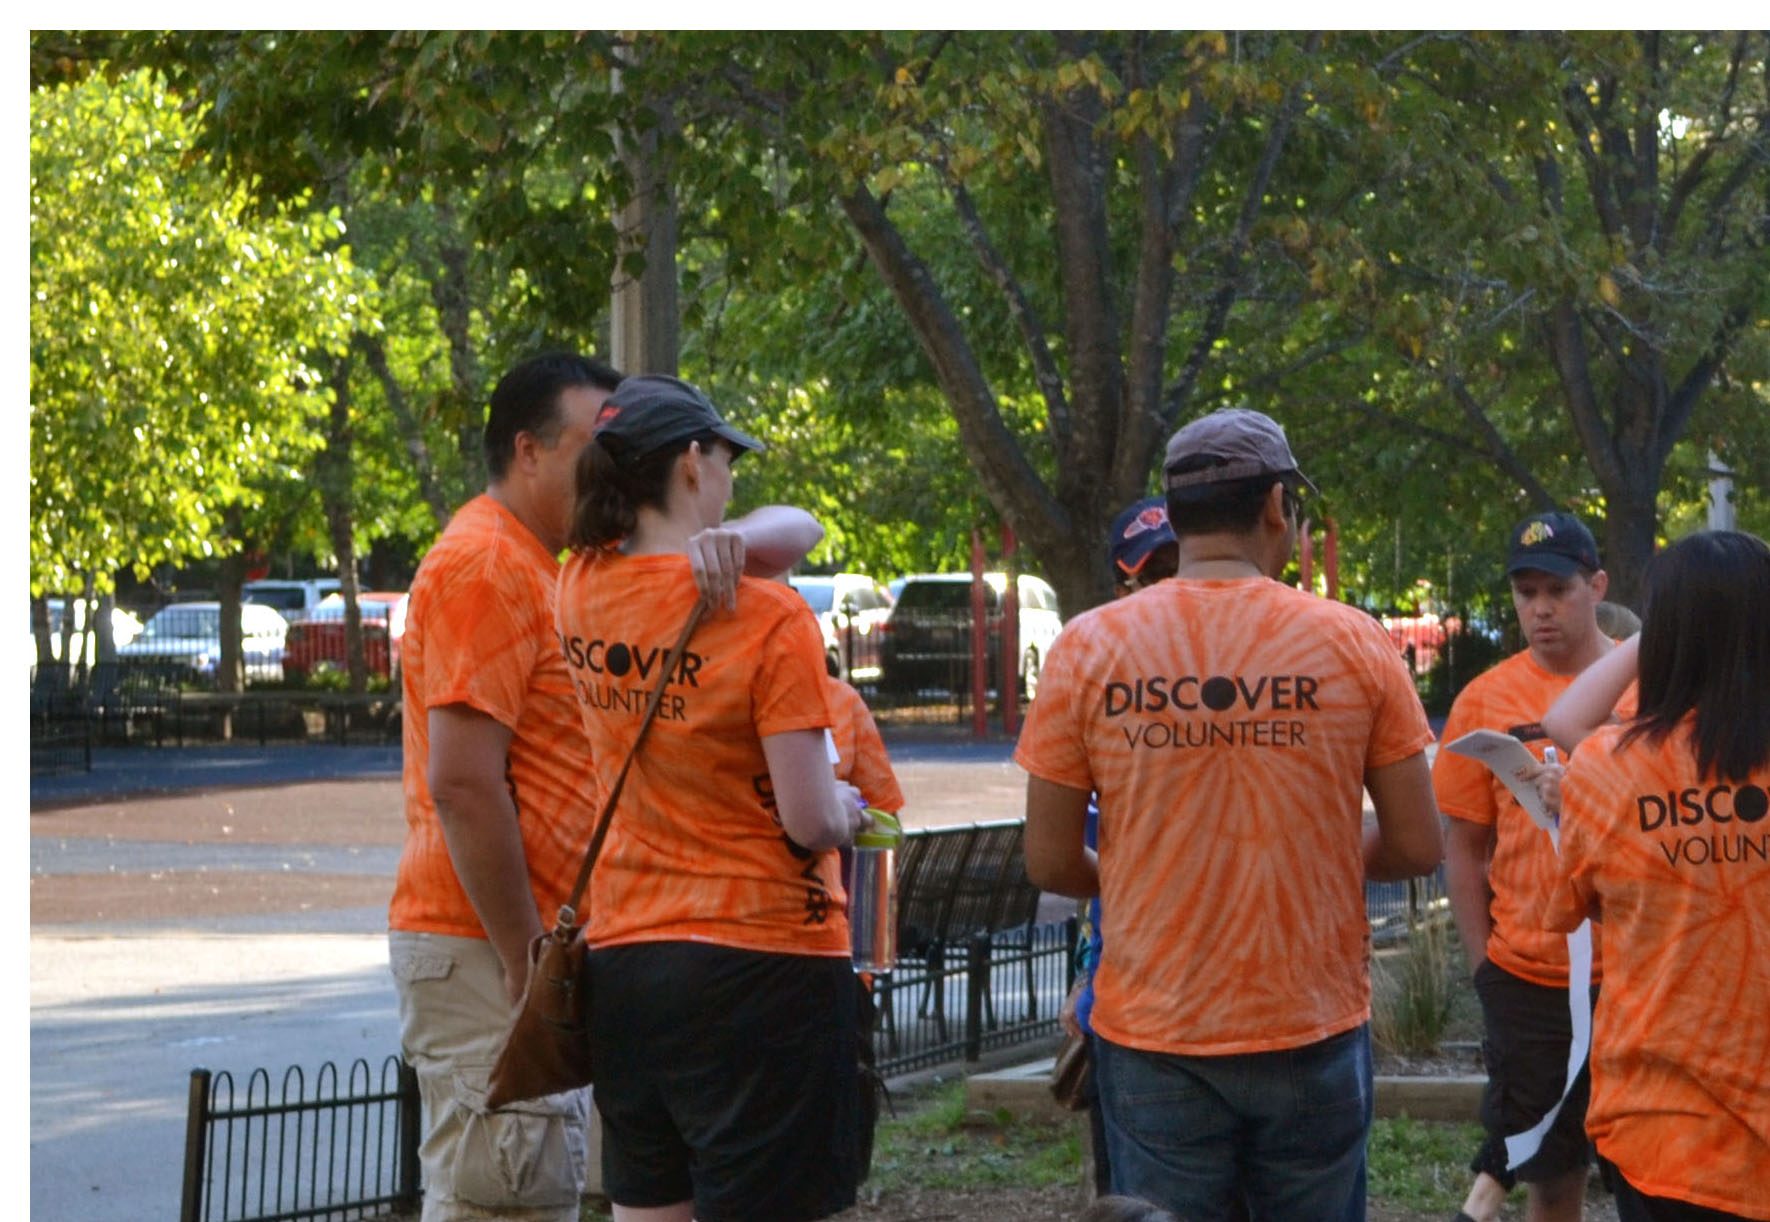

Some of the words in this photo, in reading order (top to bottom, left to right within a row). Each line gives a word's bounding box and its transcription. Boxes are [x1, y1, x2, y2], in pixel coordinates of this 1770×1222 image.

[556, 634, 704, 688] ISCOVR
[575, 679, 687, 722] OLUNTER
[1104, 676, 1321, 717] DISCOVER
[1123, 721, 1307, 750] VOLUNTEER
